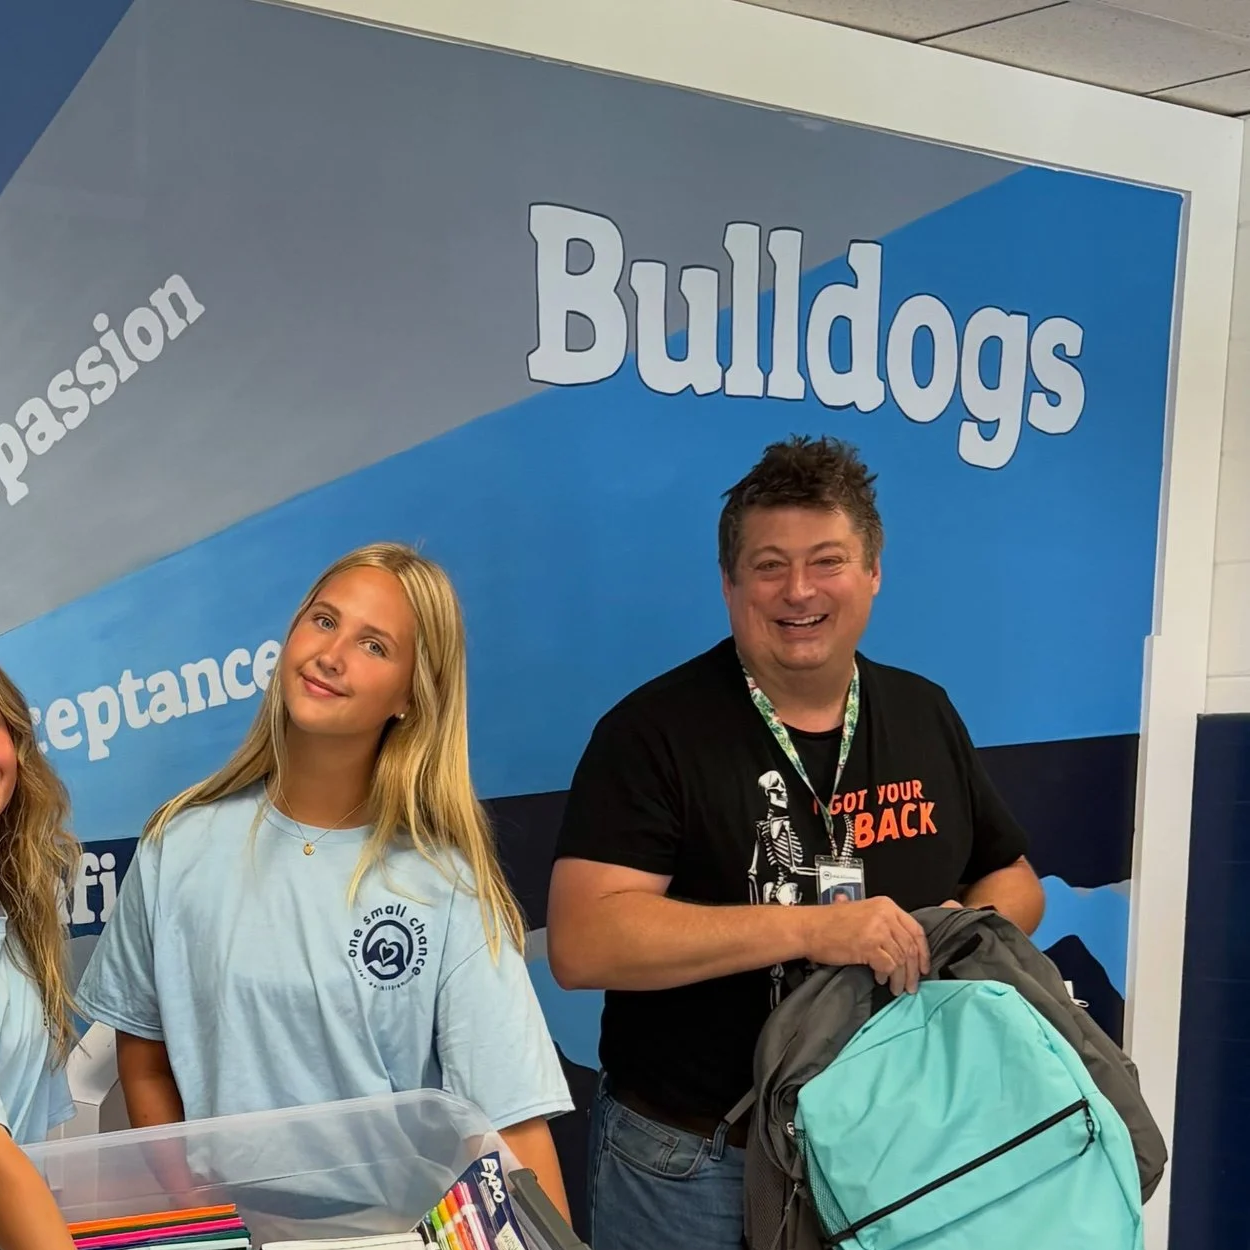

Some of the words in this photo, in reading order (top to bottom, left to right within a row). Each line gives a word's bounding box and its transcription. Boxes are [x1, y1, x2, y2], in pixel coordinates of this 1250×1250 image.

[526, 202, 1086, 470] Bulldogs
[829, 789, 868, 816] GOT
[876, 779, 925, 805] YOUR
[853, 801, 937, 849] BACK
[348, 928, 363, 958] one
[363, 903, 407, 925] small
[409, 917, 428, 976] chance
[480, 1158, 506, 1204] EXPO
